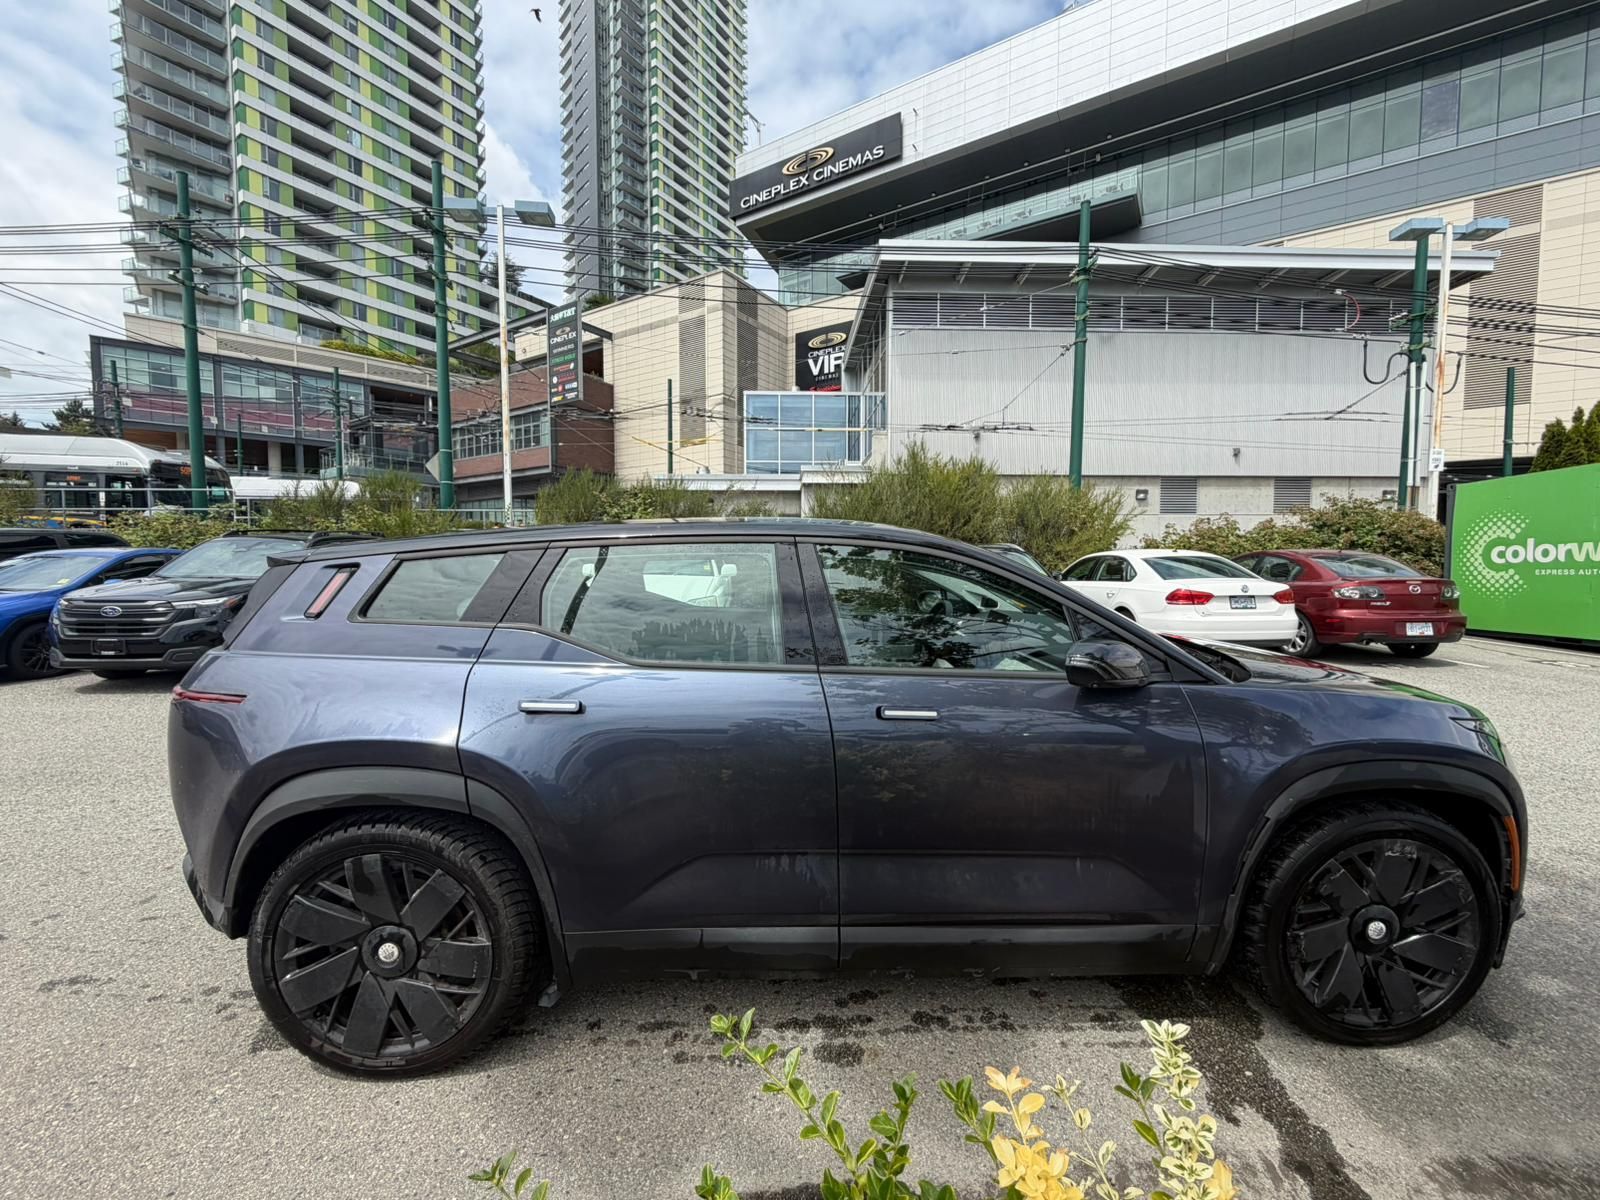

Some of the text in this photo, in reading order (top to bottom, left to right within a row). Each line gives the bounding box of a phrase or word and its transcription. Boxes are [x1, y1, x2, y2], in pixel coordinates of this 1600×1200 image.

[740, 145, 885, 209] CINEPLEX CINEMAS
[808, 345, 846, 358] CINEPLEX
[1535, 568, 1600, 576] EXPRESS AUT
